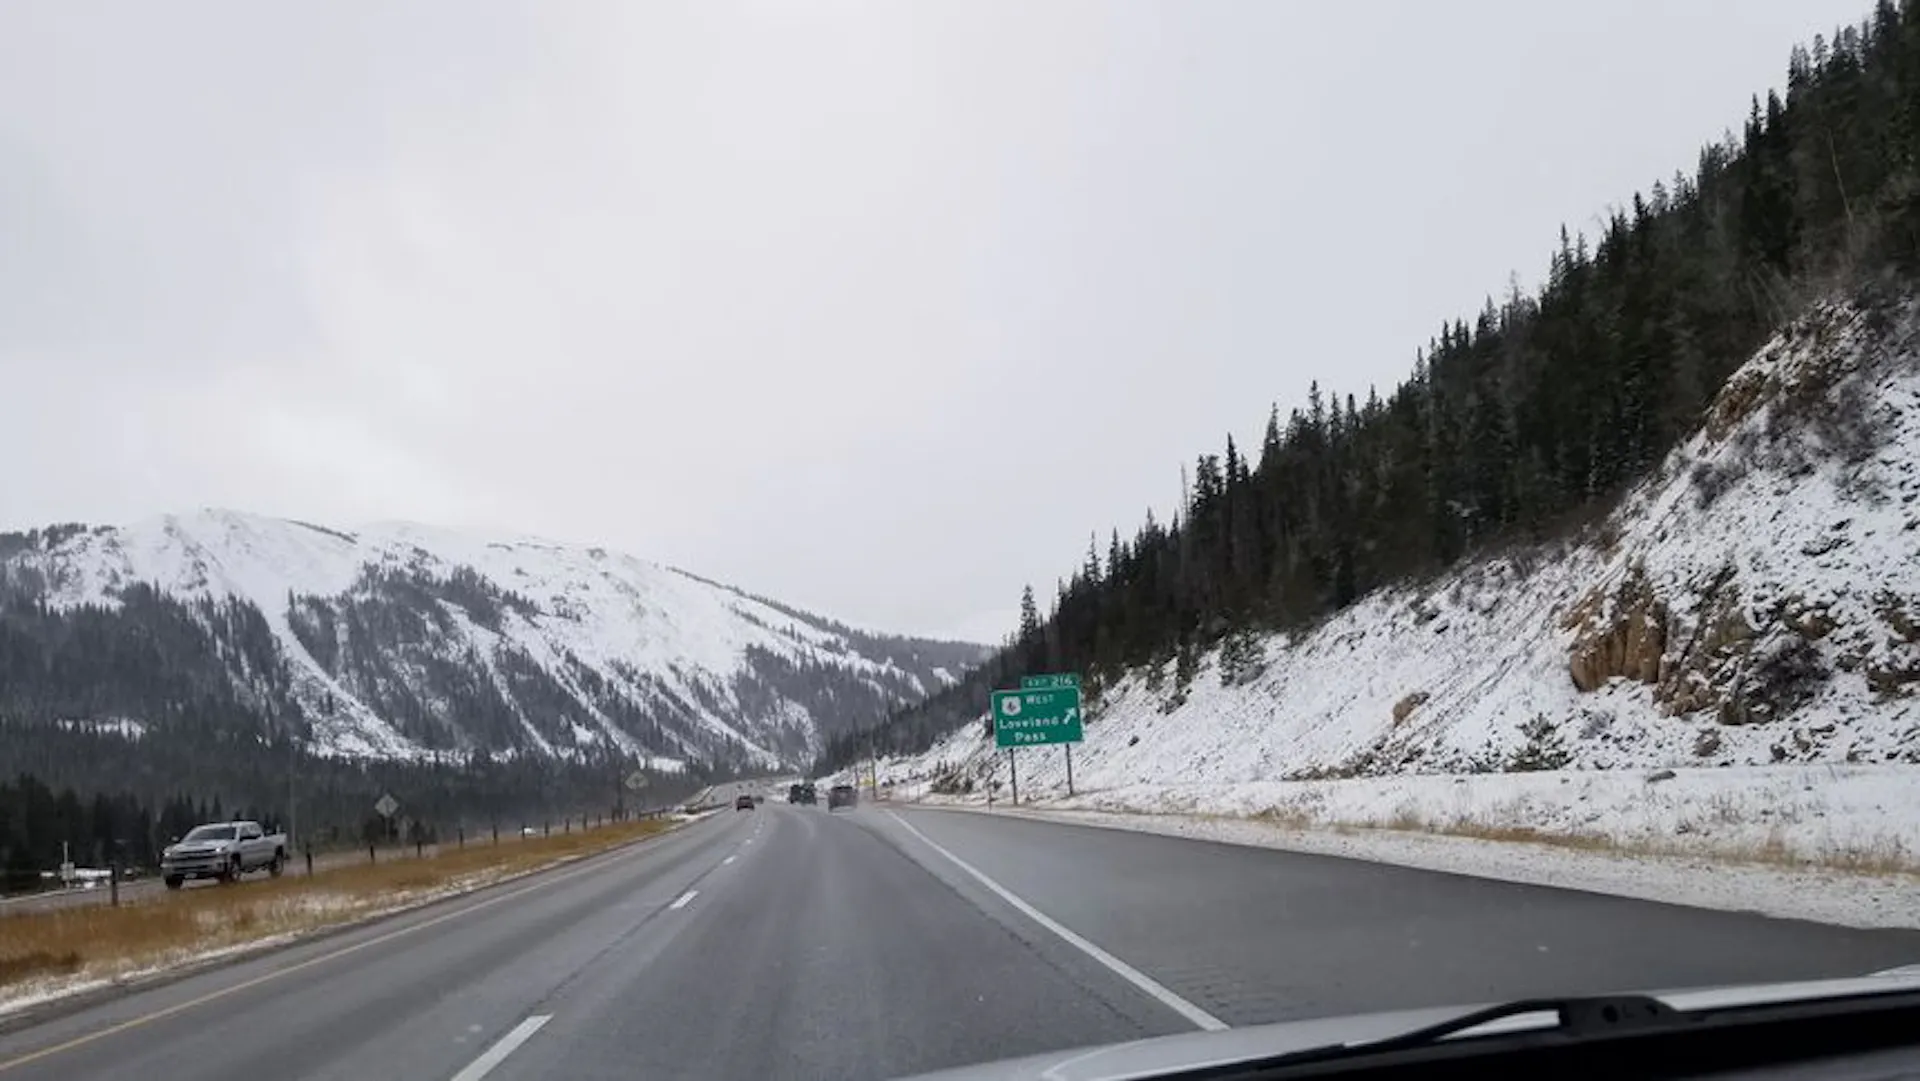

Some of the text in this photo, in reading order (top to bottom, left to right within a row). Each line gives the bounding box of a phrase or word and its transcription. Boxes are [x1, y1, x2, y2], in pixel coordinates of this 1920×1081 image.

[1051, 675, 1073, 687] 216
[999, 716, 1059, 730] Loveland
[1014, 731, 1047, 743] Pass
